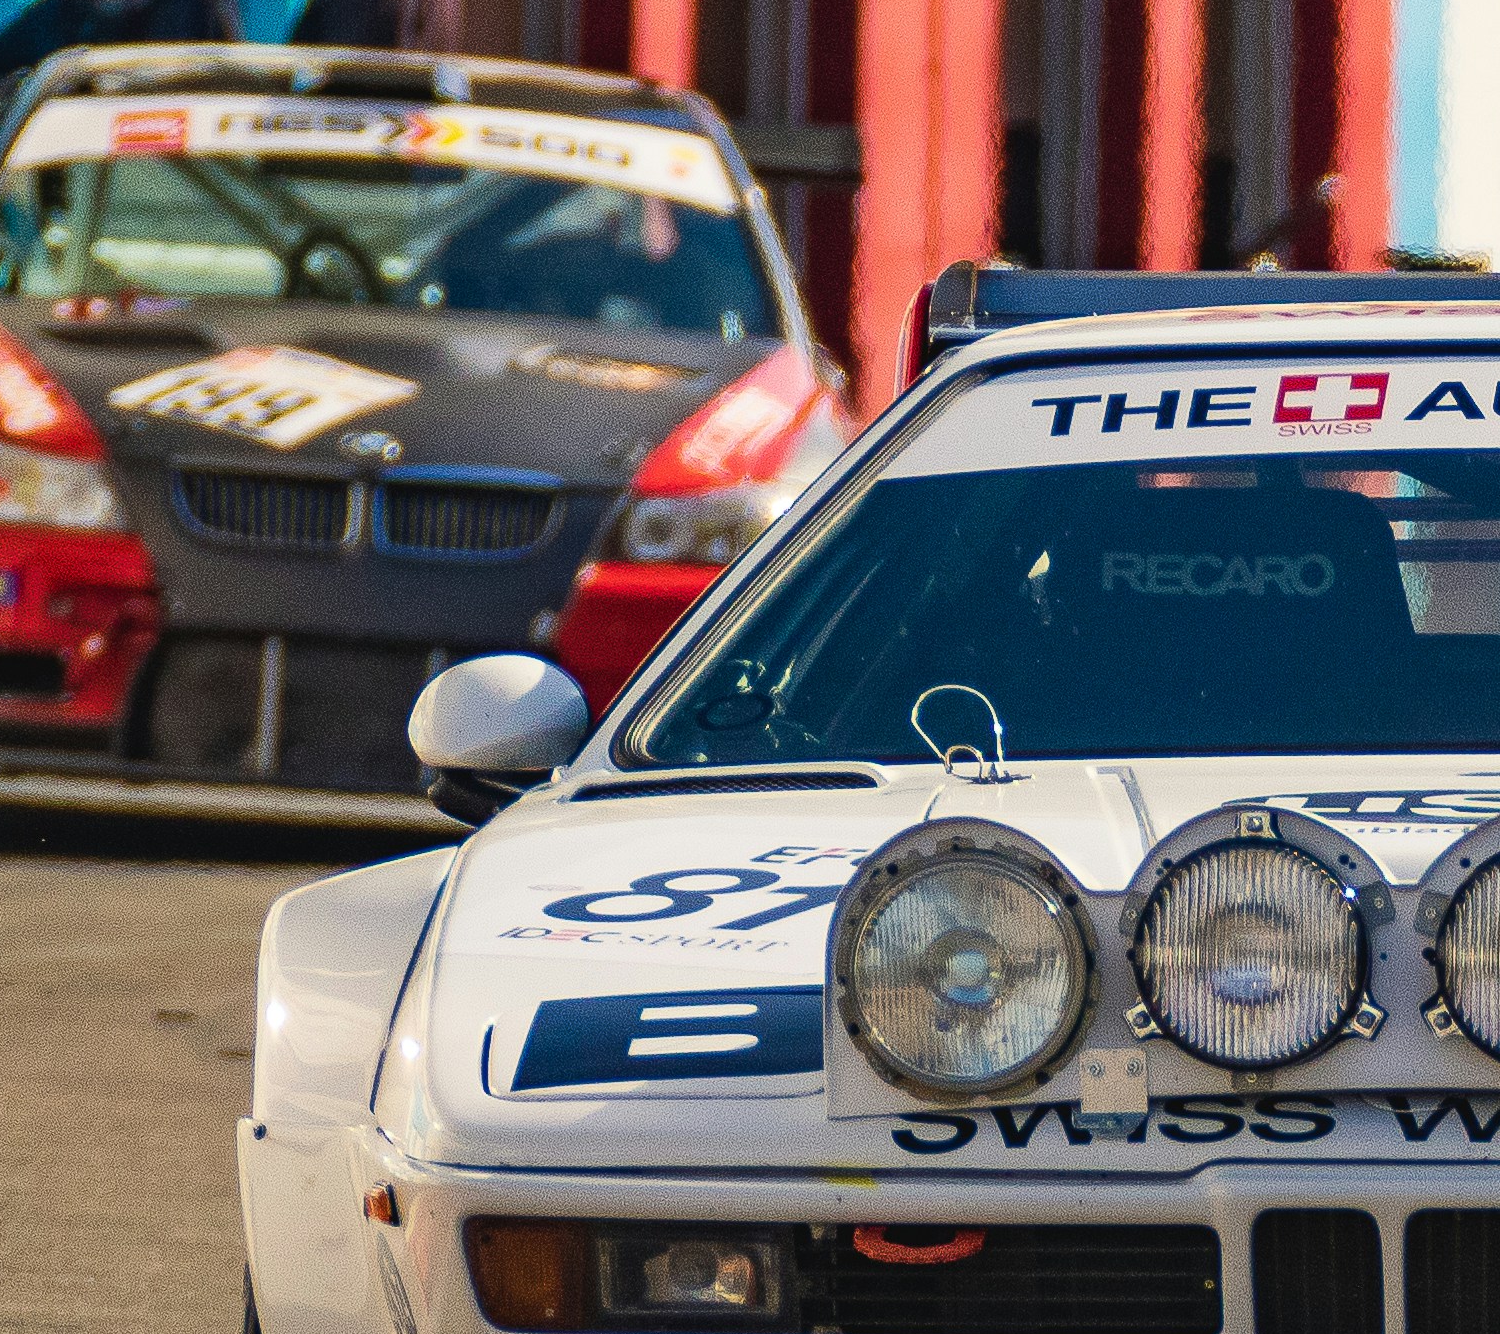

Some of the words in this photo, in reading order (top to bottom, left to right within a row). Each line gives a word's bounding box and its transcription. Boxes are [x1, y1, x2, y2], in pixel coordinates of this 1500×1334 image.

[1030, 385, 1258, 437] THE
[1277, 421, 1374, 438] SWISS
[1101, 551, 1336, 597] RECARO
[618, 932, 790, 953] SPORT
